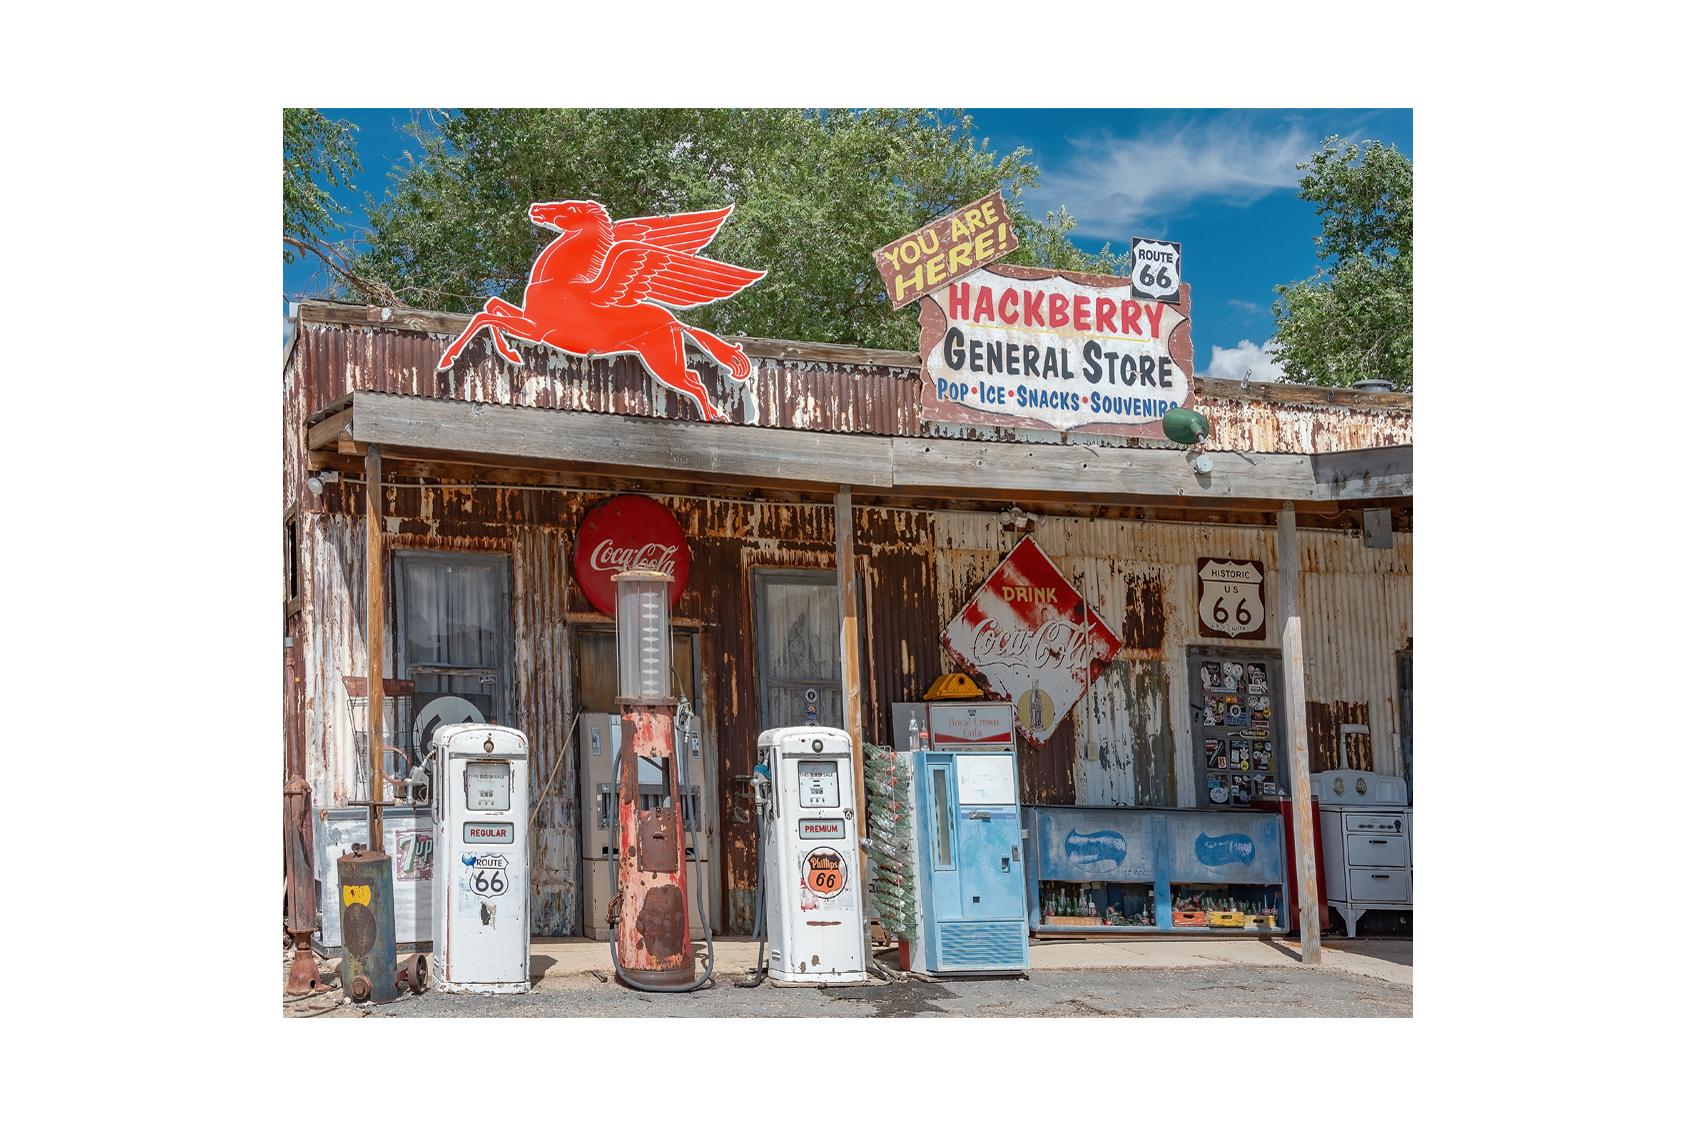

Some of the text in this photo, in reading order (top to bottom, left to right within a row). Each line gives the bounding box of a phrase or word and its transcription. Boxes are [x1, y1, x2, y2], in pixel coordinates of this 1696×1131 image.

[884, 200, 1000, 270] YOU ARE
[894, 221, 1008, 301] HERE!
[1137, 248, 1174, 264] ROUTE
[1139, 264, 1173, 289] 66
[949, 281, 1165, 340] HACKBERRY
[943, 327, 1173, 389] GENERAL STORE
[936, 376, 969, 401] POP
[979, 381, 1006, 405] ICE
[1016, 383, 1080, 411] SNACKS
[1211, 569, 1250, 580] HISTORIC
[1001, 585, 1058, 603] DRINK
[1213, 596, 1252, 626] 66
[948, 717, 1000, 728] Royal Crown
[963, 728, 982, 738] Cola
[470, 829, 507, 837] REGULAR
[804, 825, 838, 833] PREMIUM
[476, 859, 503, 867] ROUTE
[810, 857, 838, 871] Phillips
[475, 870, 504, 892] 66
[815, 872, 836, 888] 66
